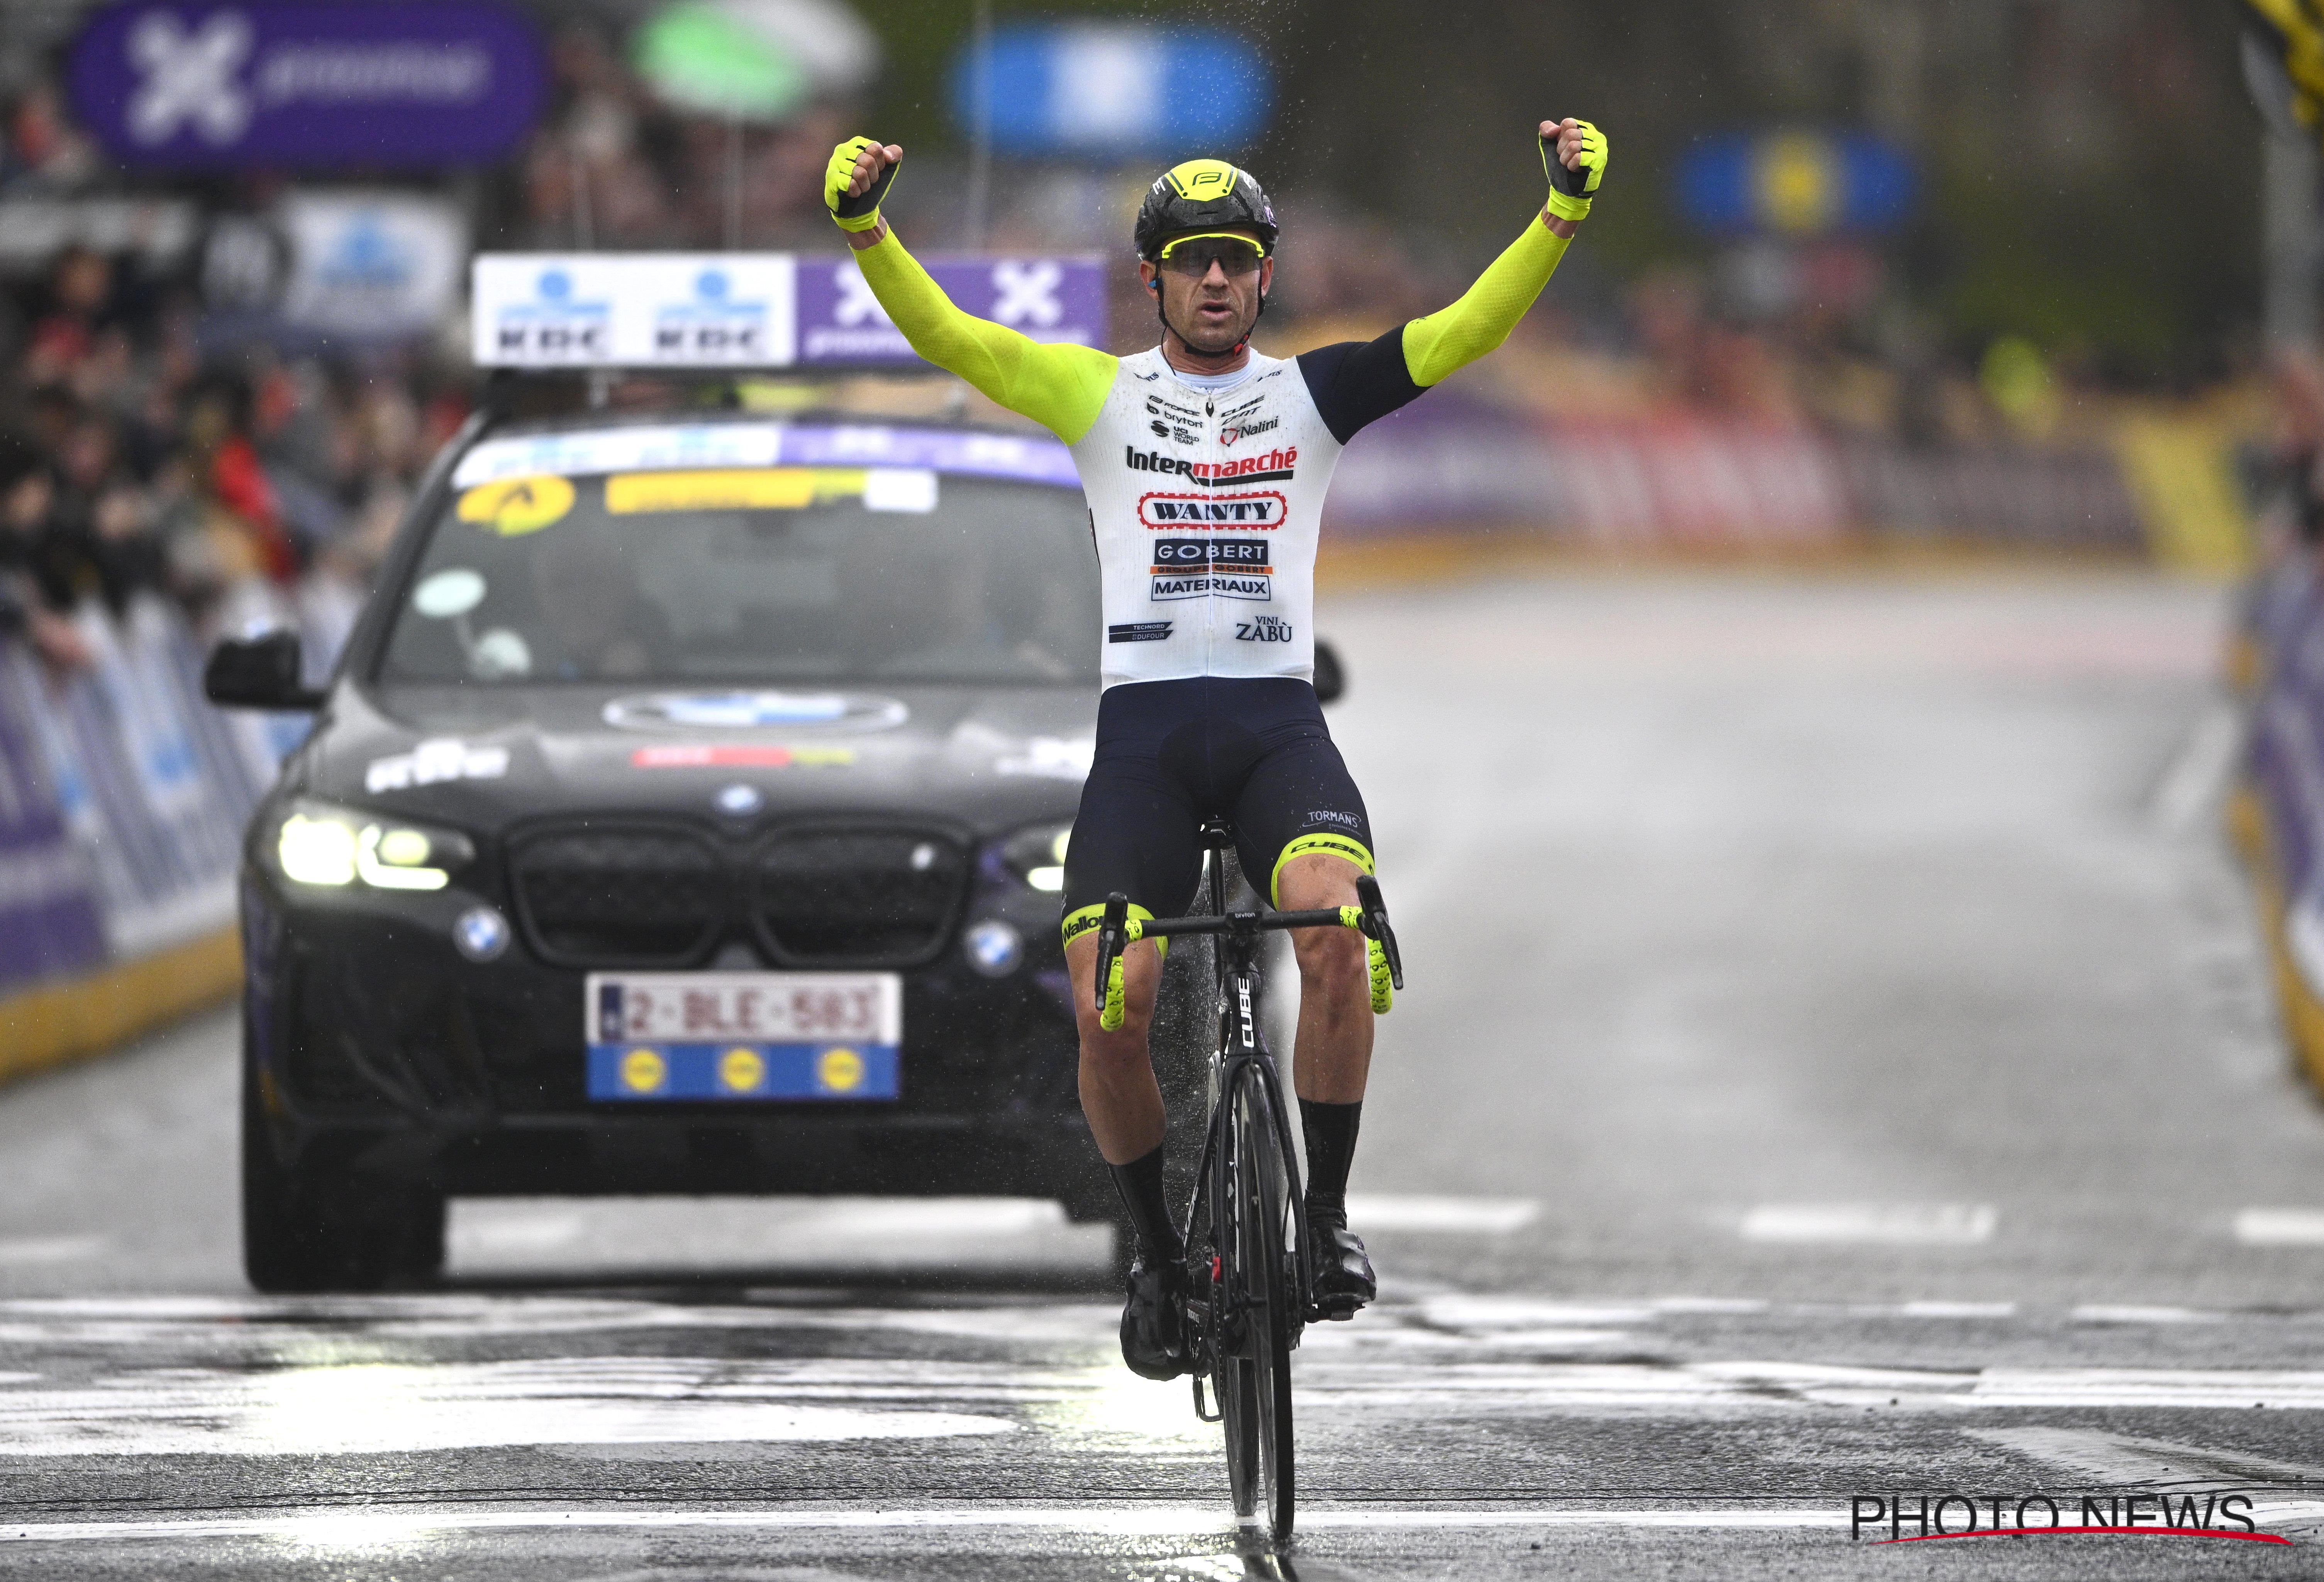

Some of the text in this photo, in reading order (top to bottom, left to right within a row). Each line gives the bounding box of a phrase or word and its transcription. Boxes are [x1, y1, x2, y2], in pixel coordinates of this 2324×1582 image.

[1164, 402, 1200, 417] FORCE
[1221, 395, 1265, 417] CUBE
[1164, 411, 1203, 429] bryton
[1240, 415, 1279, 438] Nalini
[1173, 431, 1199, 442] WORLD
[1174, 437, 1193, 446] TEAM
[1153, 502, 1272, 520] WANTY
[1158, 545, 1264, 559] GOBERT
[1158, 564, 1265, 573] GROUPE GOBERT
[1155, 579, 1266, 594] MATERIAUX
[1255, 616, 1278, 625] VINI
[1236, 622, 1292, 642] ZABÙ
[1308, 811, 1358, 828] TORMANS
[1290, 842, 1365, 861] CUBE
[1238, 977, 1254, 1048] CUBE
